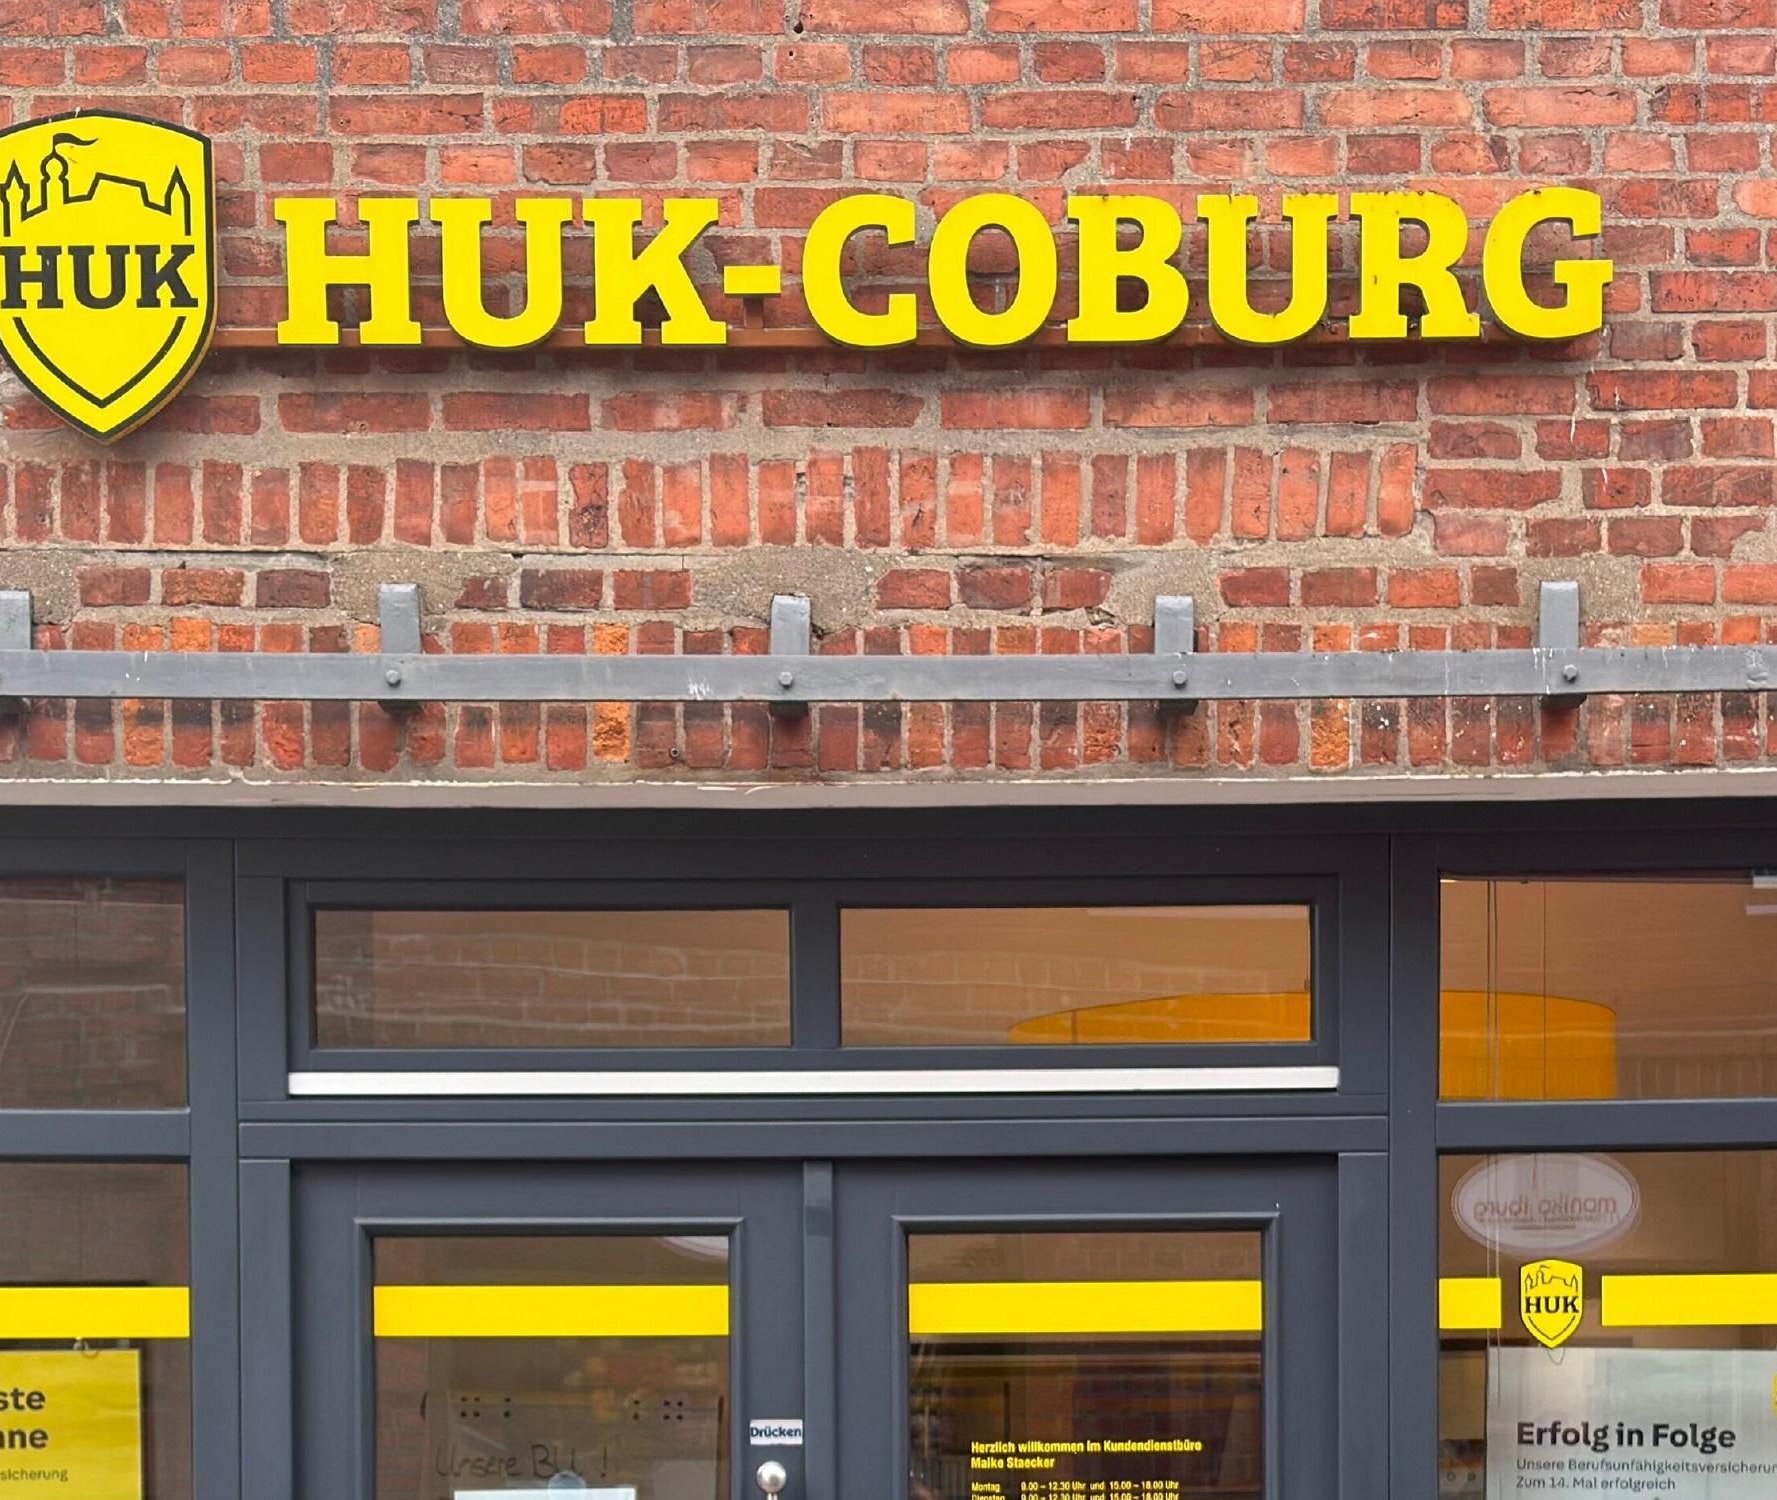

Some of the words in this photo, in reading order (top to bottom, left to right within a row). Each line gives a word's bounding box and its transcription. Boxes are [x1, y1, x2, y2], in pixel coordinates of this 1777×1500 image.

[274, 187, 1614, 350] HUK-COBURG
[0, 243, 198, 313] HUK
[1525, 1296, 1579, 1314] HUK
[750, 1425, 802, 1439] Drücken
[1517, 1422, 1609, 1452] Erfolg
[1617, 1423, 1644, 1447] in
[1652, 1424, 1736, 1454] Folge
[971, 1442, 1015, 1453] Herzlich
[1018, 1442, 1084, 1452] willkommen
[1087, 1441, 1101, 1451] im
[1103, 1440, 1202, 1451] Kundendienstbüro
[971, 1457, 1003, 1469] Maike
[1006, 1457, 1055, 1468] Staecker
[1517, 1459, 1564, 1471] Unsere
[972, 1482, 1000, 1492] Montag
[1048, 1481, 1070, 1490] 12.30
[1072, 1481, 1086, 1490] Uhr
[1090, 1481, 1105, 1490] und
[1110, 1481, 1131, 1490] 15.00
[1165, 1480, 1179, 1489] Uhr
[1516, 1477, 1546, 1488] Zum
[1573, 1477, 1597, 1489] Mal
[1601, 1478, 1675, 1491] erfolgreich
[1165, 1492, 1179, 1500] Uhr
